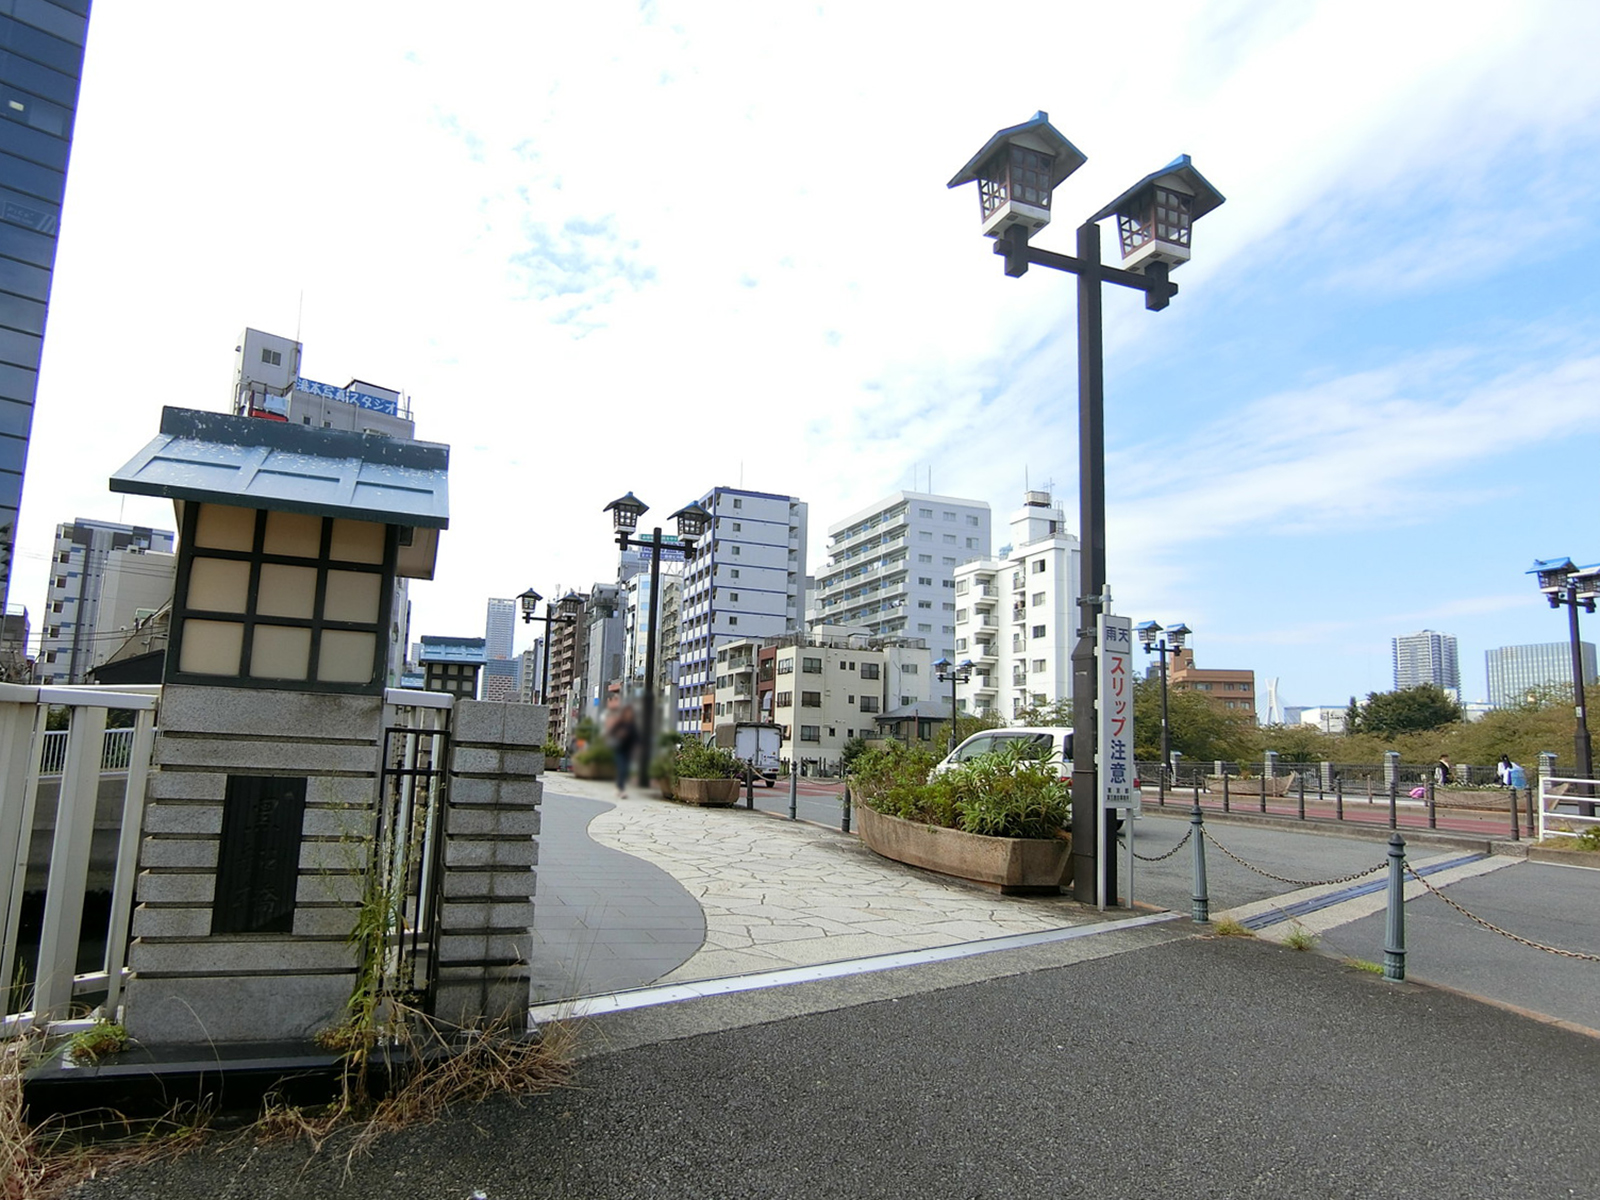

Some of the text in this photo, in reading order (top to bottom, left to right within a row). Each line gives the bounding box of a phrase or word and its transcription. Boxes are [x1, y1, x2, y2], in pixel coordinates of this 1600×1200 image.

[1106, 626, 1129, 643] 雨天
[1110, 656, 1127, 784] スリップ注意
